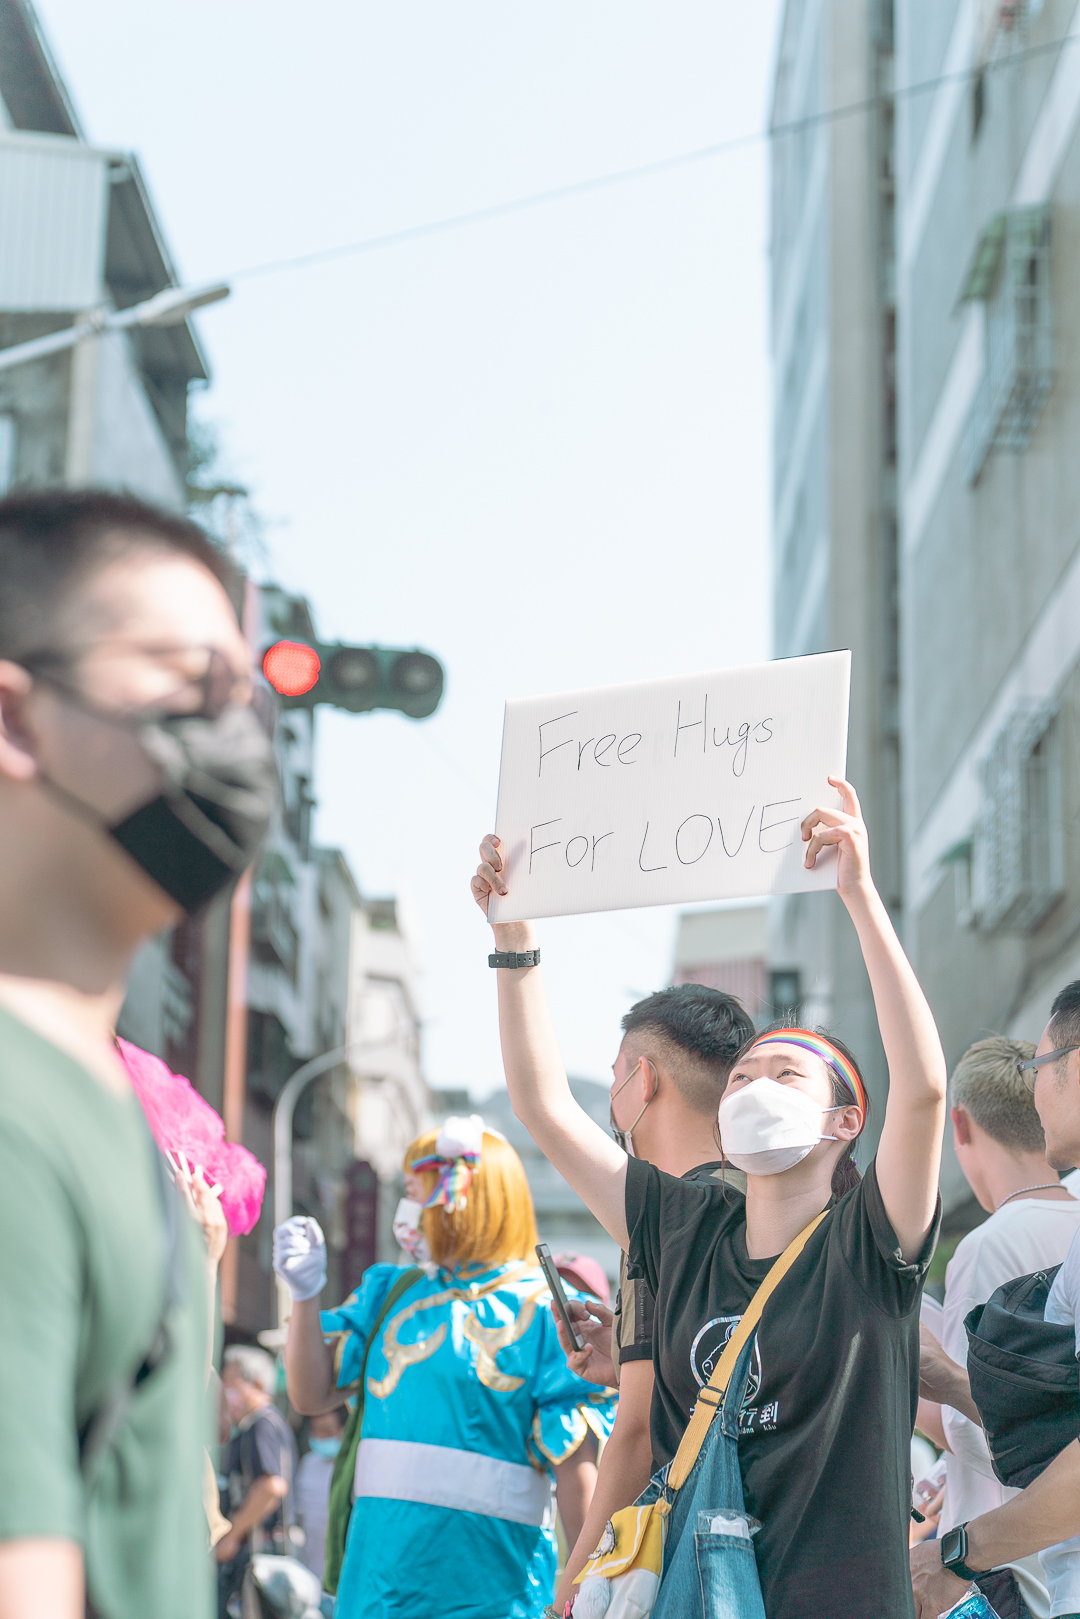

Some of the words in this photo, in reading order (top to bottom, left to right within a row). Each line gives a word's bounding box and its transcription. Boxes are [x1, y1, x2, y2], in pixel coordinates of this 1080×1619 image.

[538, 710, 642, 778] Free
[673, 693, 774, 778] Hugs
[528, 818, 615, 875] For
[638, 797, 802, 873] LOVE
